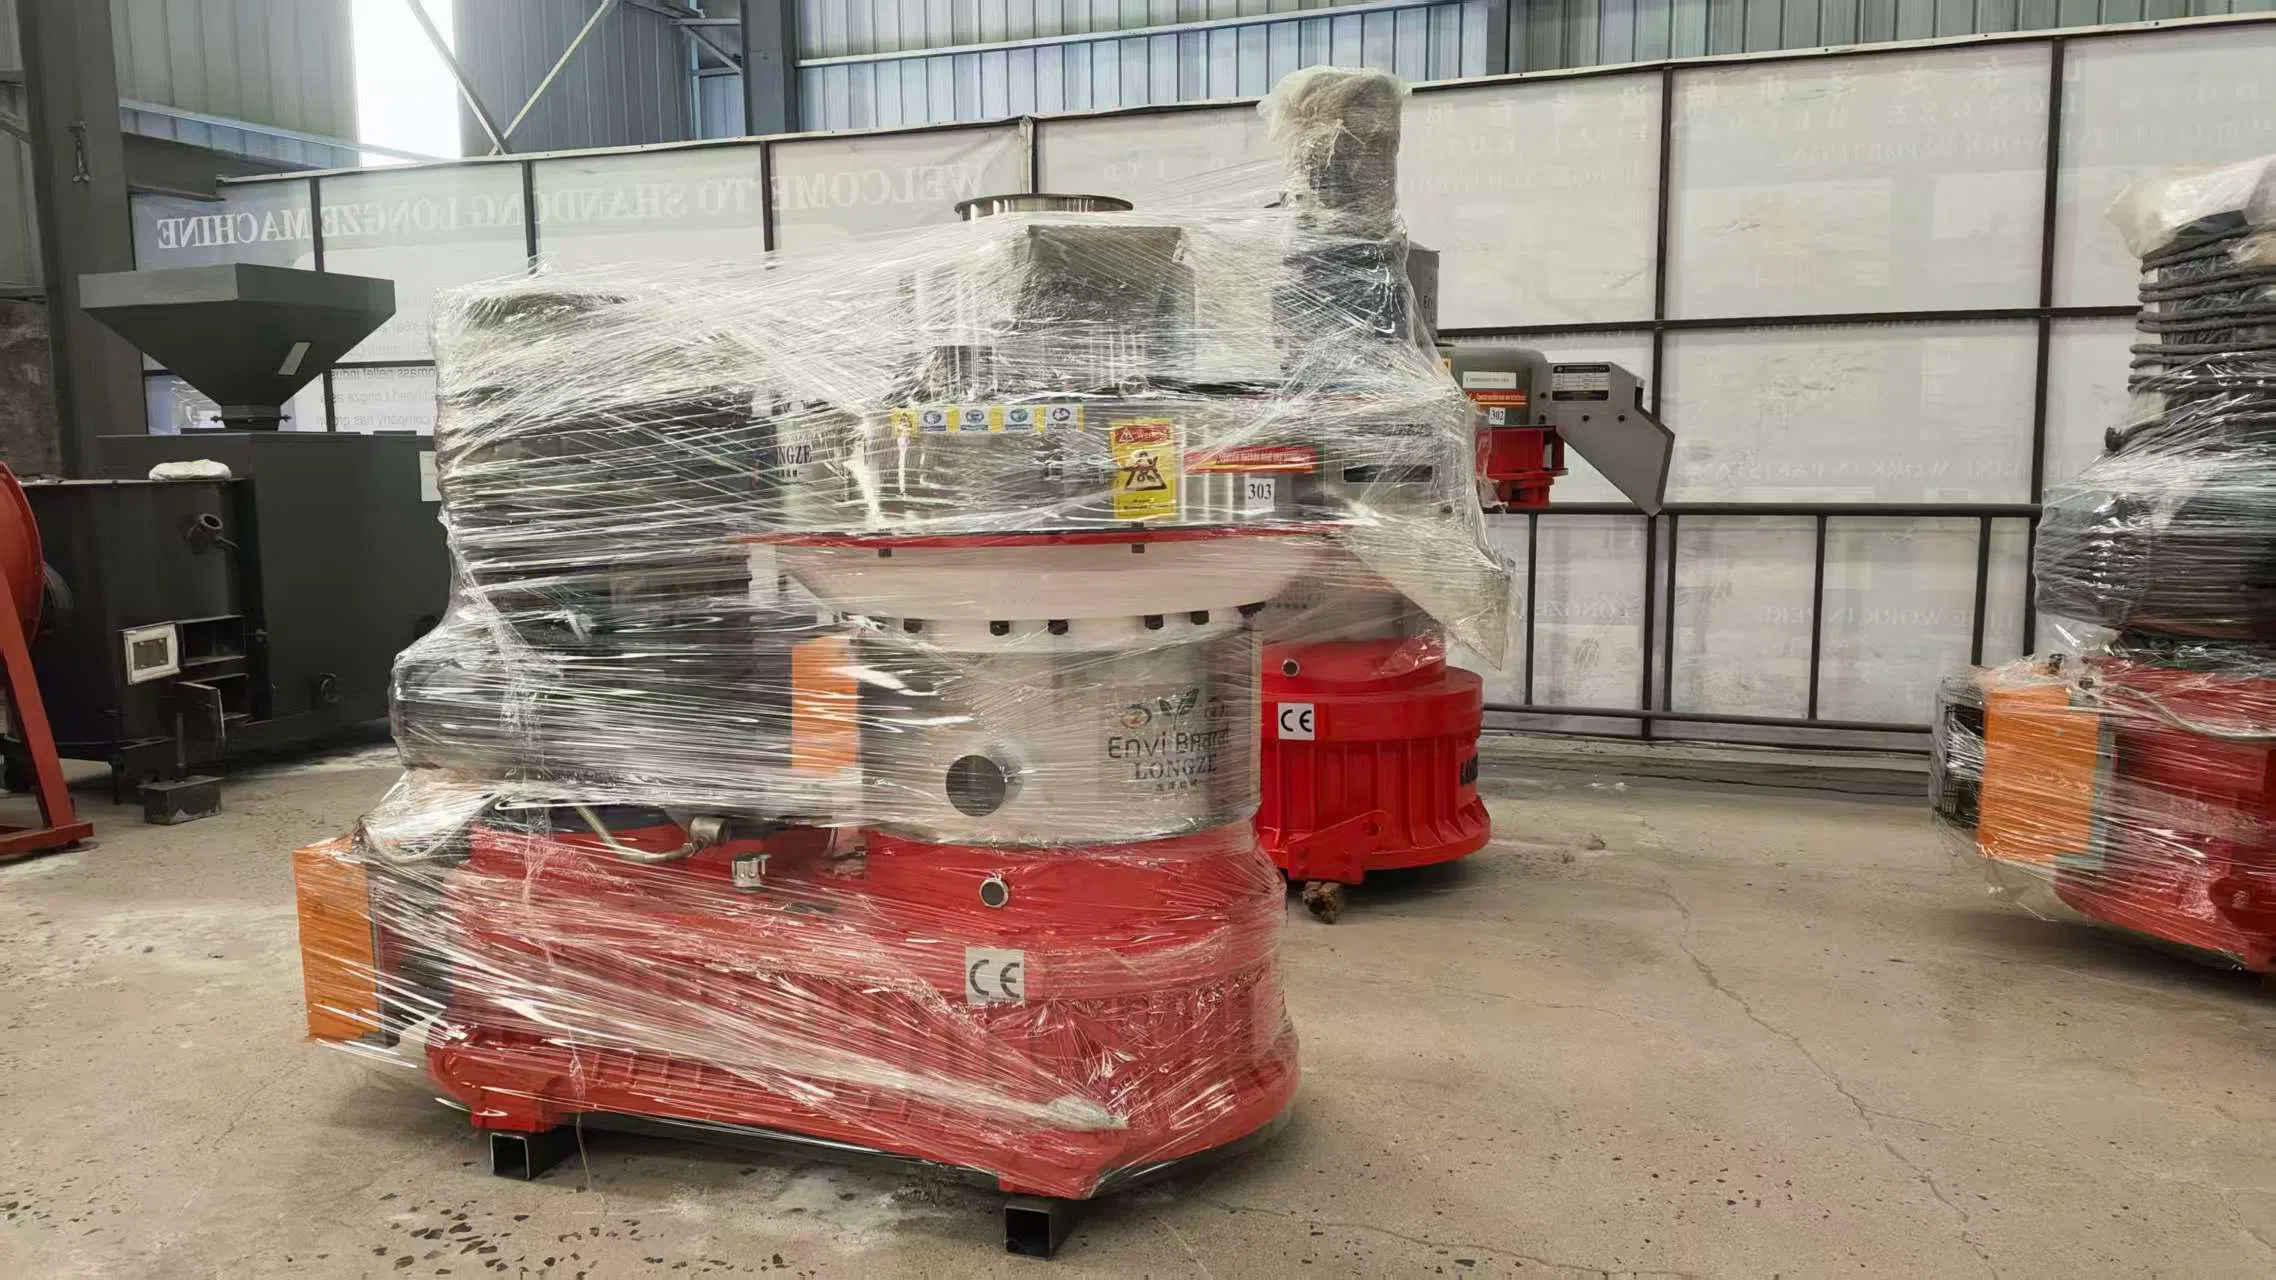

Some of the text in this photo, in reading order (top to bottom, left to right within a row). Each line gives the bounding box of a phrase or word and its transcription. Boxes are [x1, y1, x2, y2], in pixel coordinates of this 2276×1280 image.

[1490, 410, 1504, 421] 302
[776, 445, 812, 464] NGZE
[1248, 483, 1272, 500] 303
[1281, 709, 1312, 732] CE
[1134, 753, 1217, 780] LONGZE
[970, 959, 1020, 999] CE
